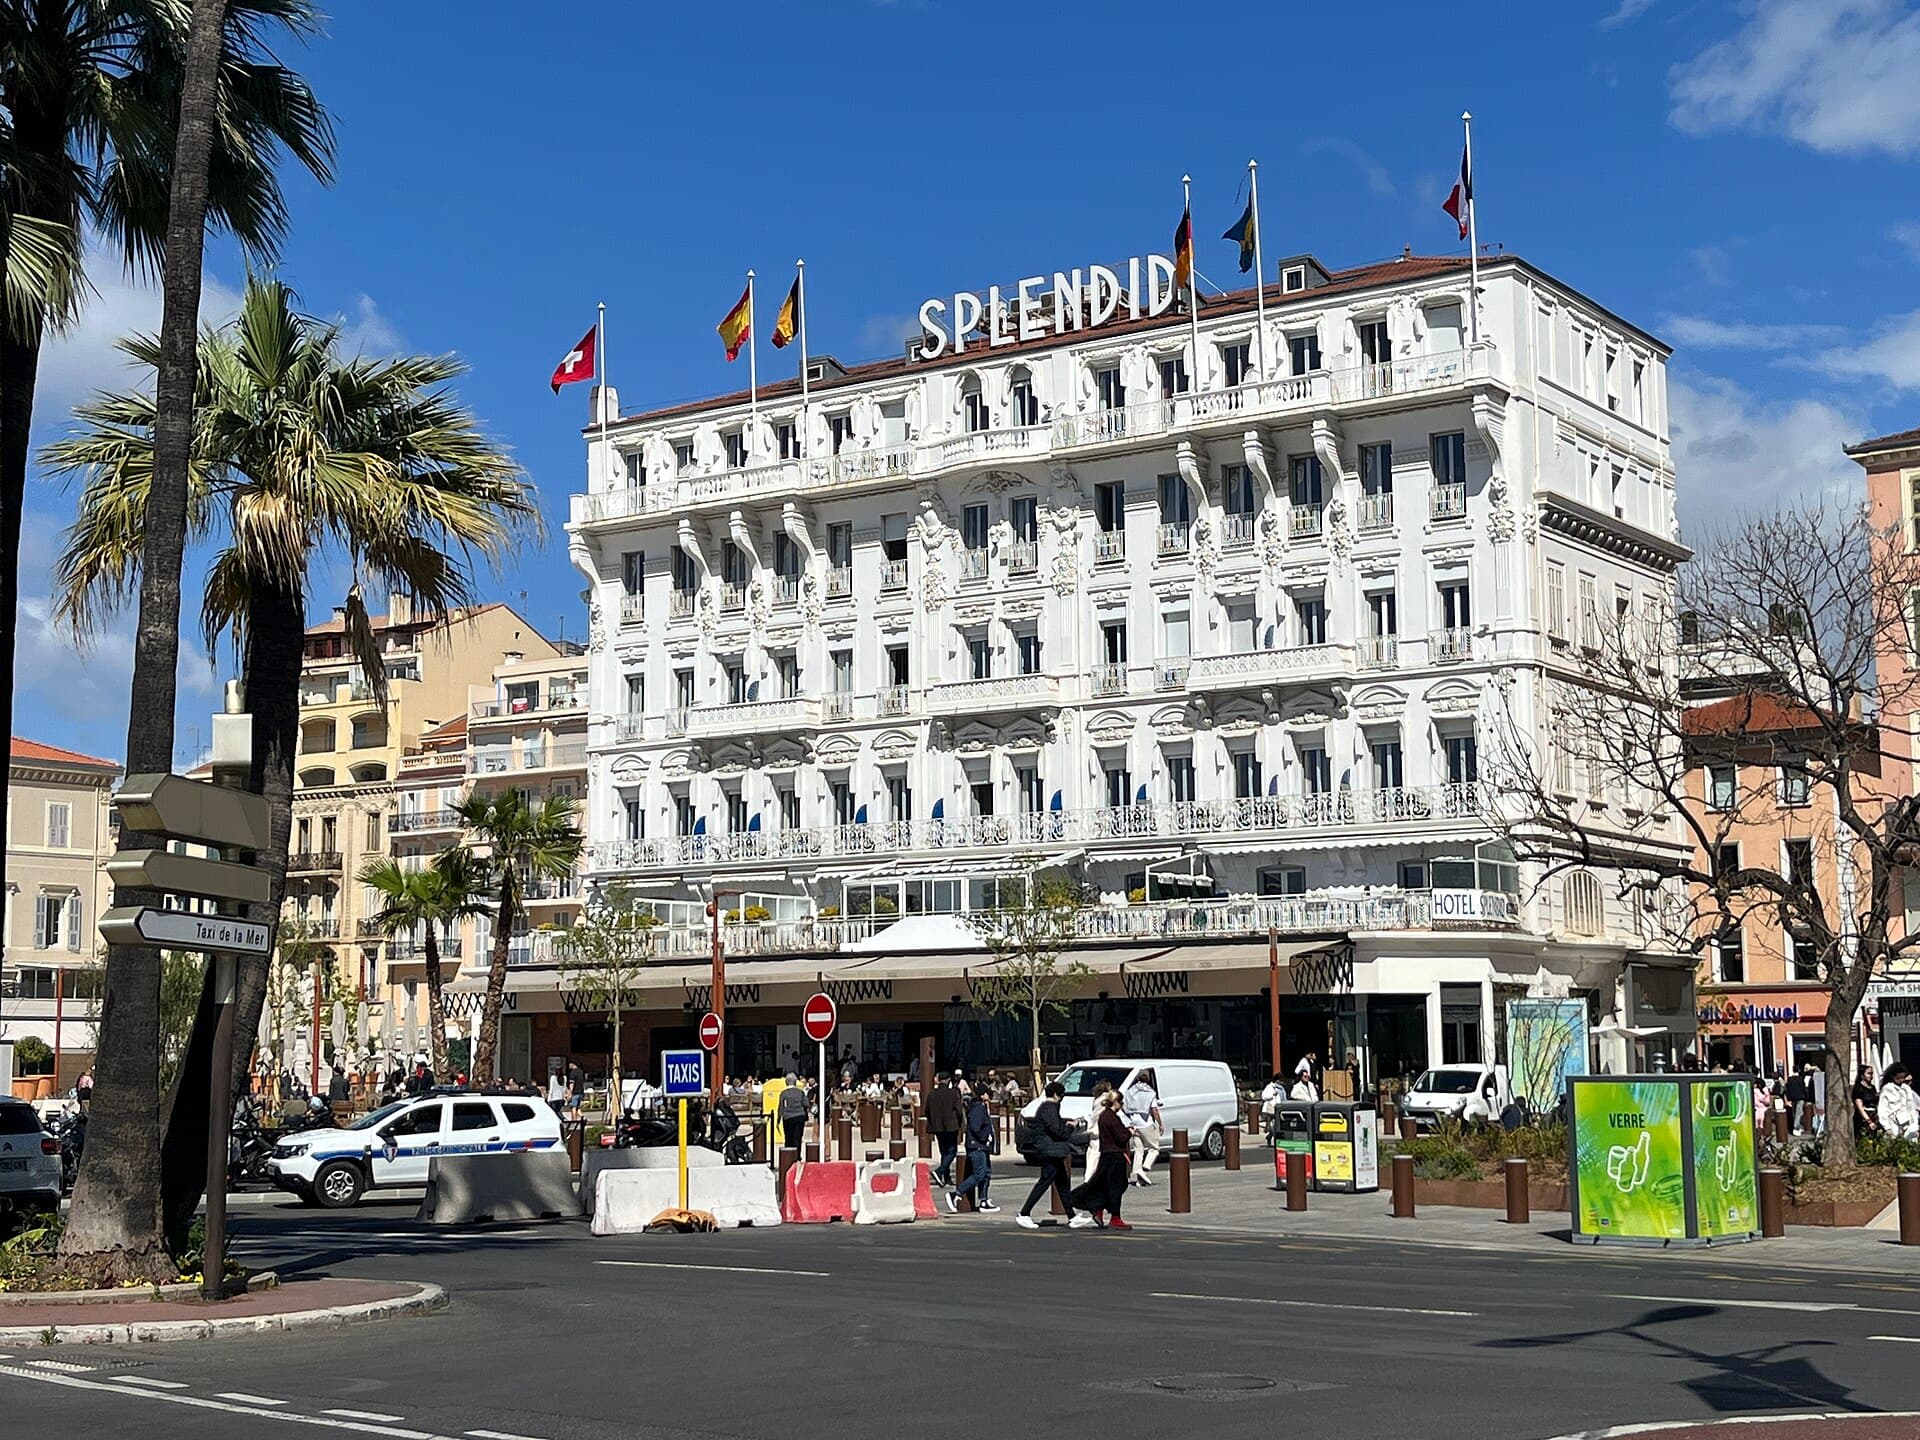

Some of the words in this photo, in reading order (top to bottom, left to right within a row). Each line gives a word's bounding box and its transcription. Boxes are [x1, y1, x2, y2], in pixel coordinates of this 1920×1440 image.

[918, 254, 1176, 360] SPLENDID
[1434, 894, 1476, 915] HOTEL
[196, 922, 217, 940] Taxi
[219, 926, 231, 942] de
[233, 927, 243, 943] la
[245, 929, 265, 946] Mer
[1740, 1003, 1798, 1022] Mutuel
[667, 1062, 700, 1084] TAXIS
[1608, 1112, 1646, 1129] VERRE
